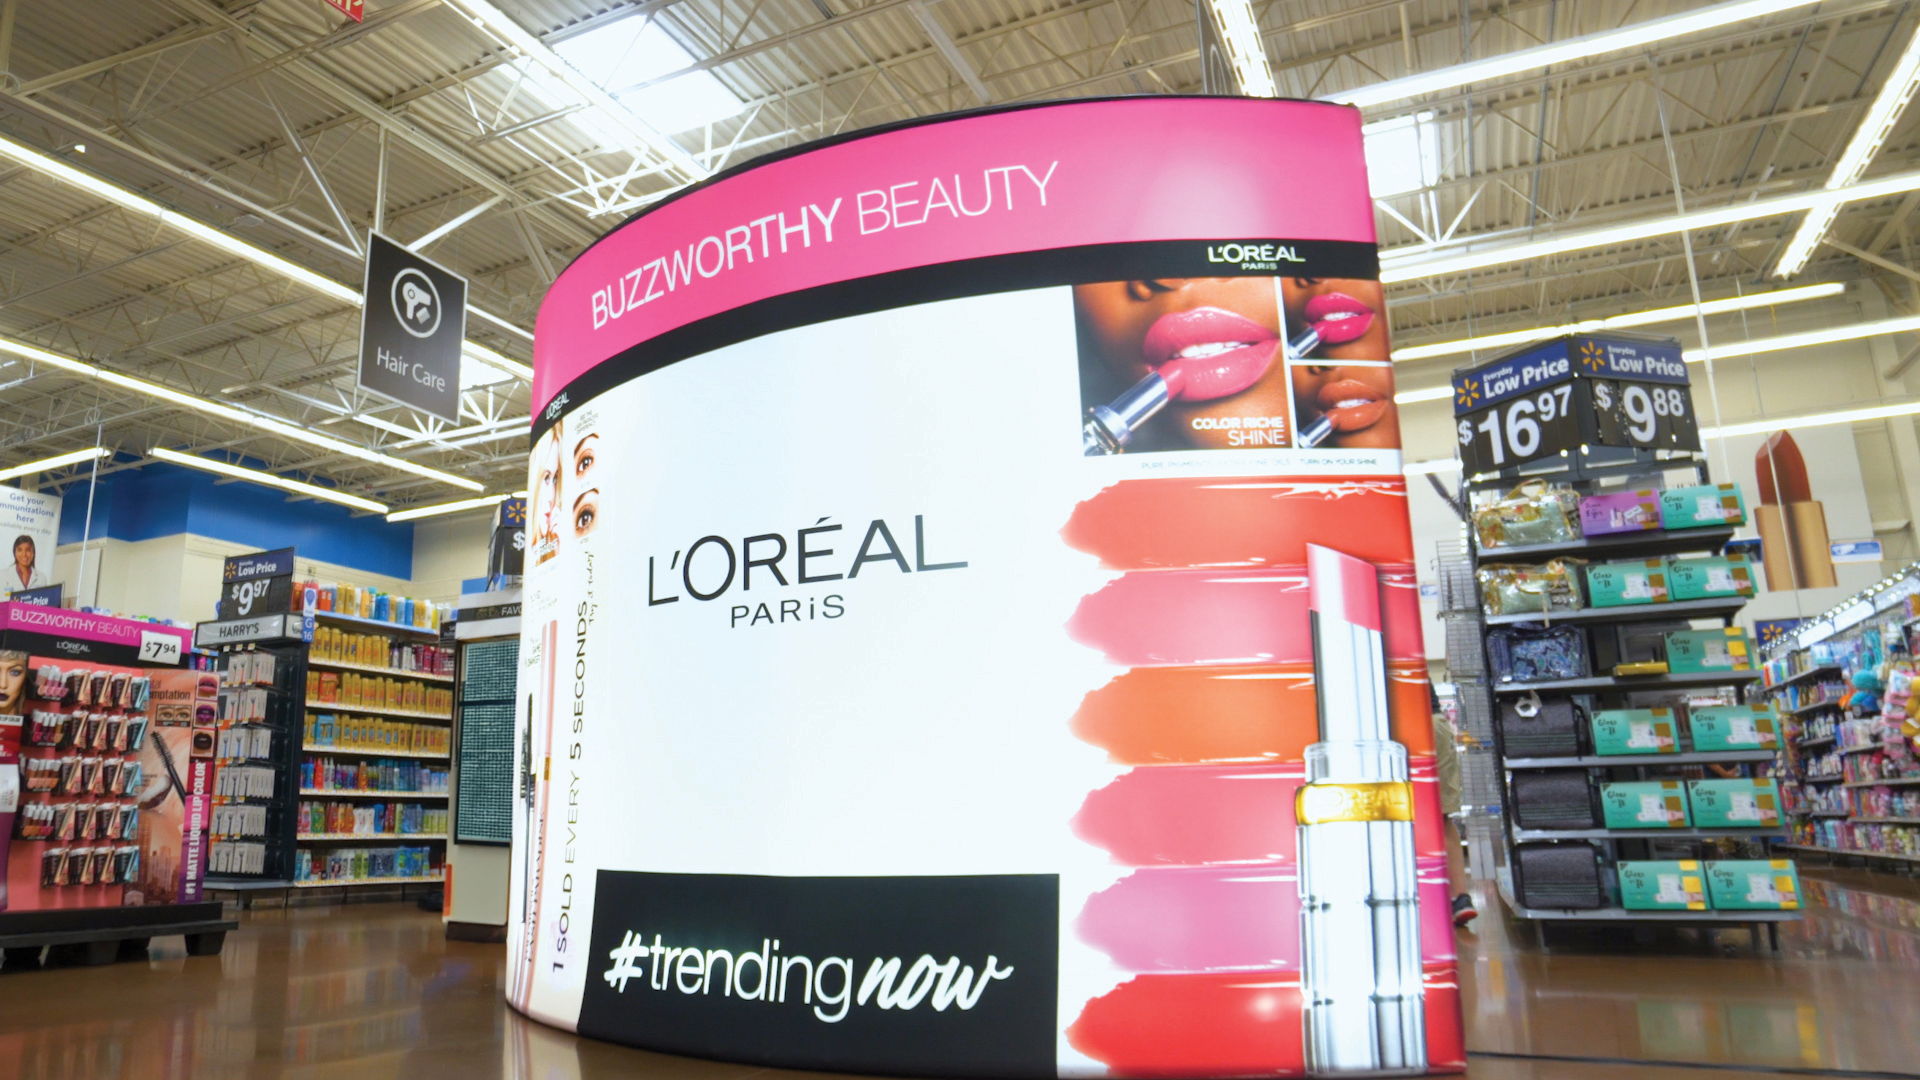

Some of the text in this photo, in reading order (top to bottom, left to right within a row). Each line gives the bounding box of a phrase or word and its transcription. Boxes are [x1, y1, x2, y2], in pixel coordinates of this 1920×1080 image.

[591, 160, 1059, 330] BUZZWORTHY BEAUTY
[1608, 345, 1636, 357] Everyday
[376, 346, 446, 393] Hair Care
[1483, 366, 1513, 382] Everyday
[1609, 353, 1685, 377] Low Price
[1484, 357, 1569, 399] Low Price
[1192, 416, 1284, 430] COLOR RICHE
[1228, 428, 1285, 446] SHINE
[10, 493, 45, 506] Get your
[0, 503, 54, 517] mmunizations
[16, 514, 35, 523] here
[238, 562, 277, 577] Low Price
[648, 514, 968, 607] L'ORÉAL
[10, 608, 139, 638] BUZZWORTHY BEAUTY
[219, 623, 259, 638] HARRY'S
[305, 618, 313, 629] G
[303, 631, 312, 640] 16
[573, 601, 588, 734] SECONDS
[570, 742, 581, 760] 5
[192, 797, 203, 812] LIP
[565, 770, 581, 863] EVERY
[190, 813, 202, 848] LIQUID
[186, 848, 200, 880] MATTE
[185, 882, 196, 895] #1
[557, 873, 573, 953] SOLD
